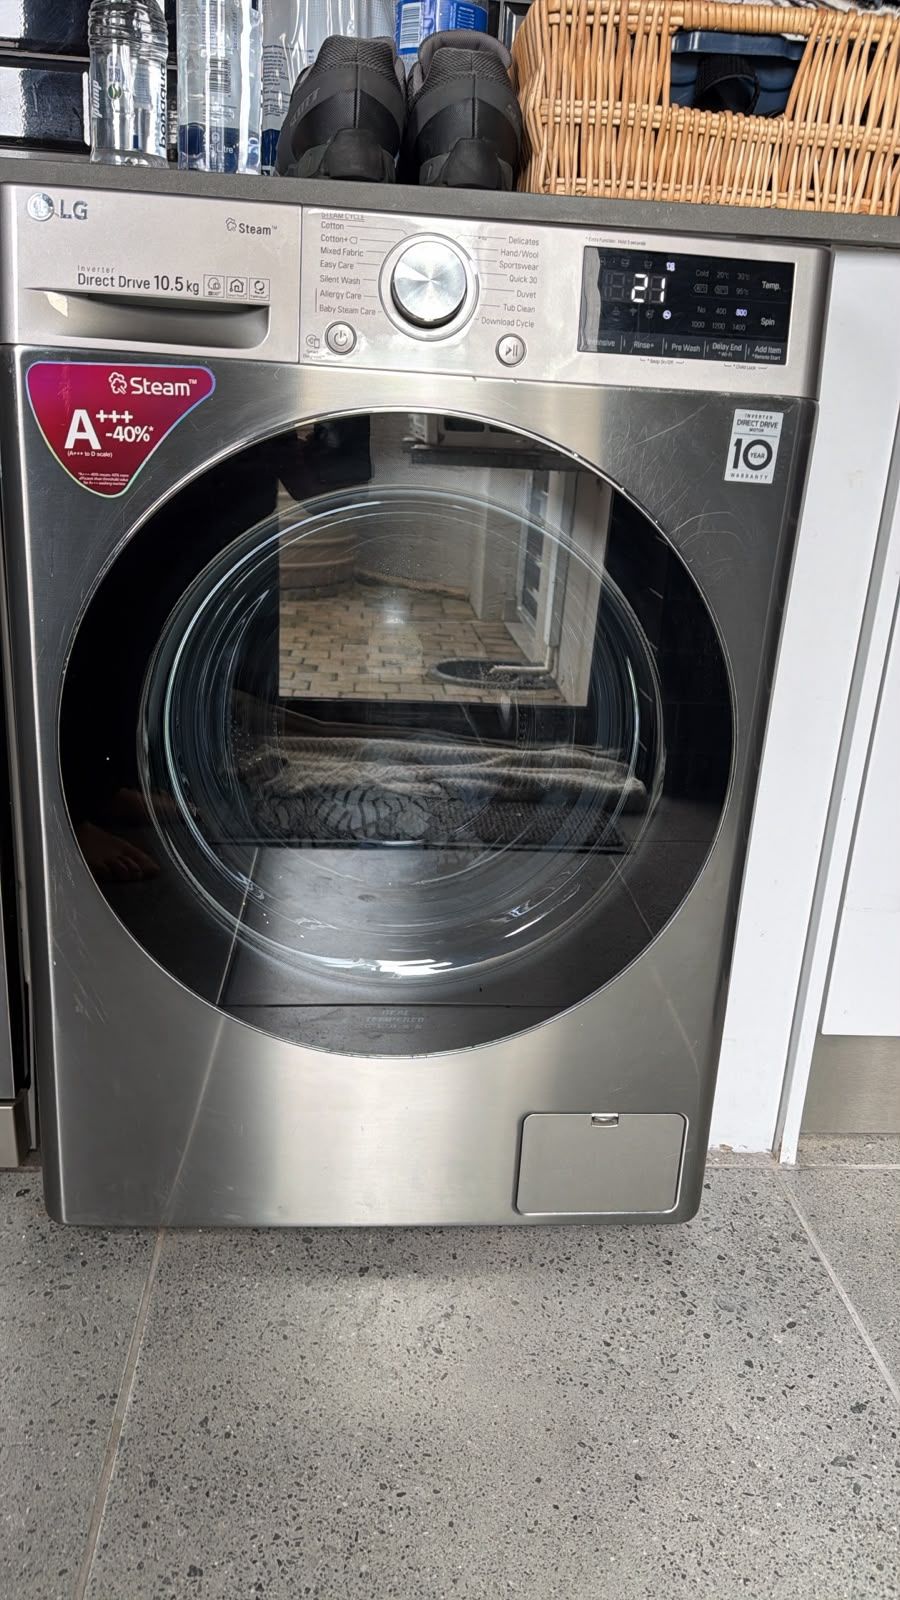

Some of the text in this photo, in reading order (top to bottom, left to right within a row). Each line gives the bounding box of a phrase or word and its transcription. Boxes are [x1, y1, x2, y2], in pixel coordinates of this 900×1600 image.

[90, 80, 103, 119] pump
[159, 62, 167, 148] bonaqua
[60, 199, 88, 220] LG
[321, 221, 344, 230] Cotton
[320, 234, 347, 243] Cotton+
[508, 235, 539, 246] Delicates
[320, 247, 364, 257] Mixed Fabric
[500, 248, 539, 259] Hand/Wool
[77, 265, 115, 274] Inverter
[320, 260, 354, 270] Easy Care
[499, 260, 539, 271] Sportswear
[77, 273, 200, 296] Direct Drive 10.5 kg
[320, 275, 361, 285] Silent Wash
[509, 274, 538, 284] Quick 30
[631, 273, 666, 303] 21
[761, 280, 781, 291] Temp.
[320, 290, 362, 300] Allergy Care
[516, 290, 537, 299] Duvet
[320, 304, 376, 316] Baby Steam Care
[504, 303, 536, 313] Tub Clean
[716, 307, 727, 315] 400
[735, 308, 748, 317] 800
[481, 316, 535, 328] Download Cycle
[691, 321, 705, 329] 1000
[711, 322, 726, 330] 1200
[760, 317, 775, 327] Spin
[633, 340, 655, 349] Rinse+
[671, 343, 682, 351] Pre
[683, 344, 701, 353] Wash
[712, 342, 730, 352] Delay
[730, 343, 743, 352] End
[754, 346, 768, 354] Add
[737, 419, 778, 429] DIRECT DRIVE
[733, 438, 773, 471] 10
